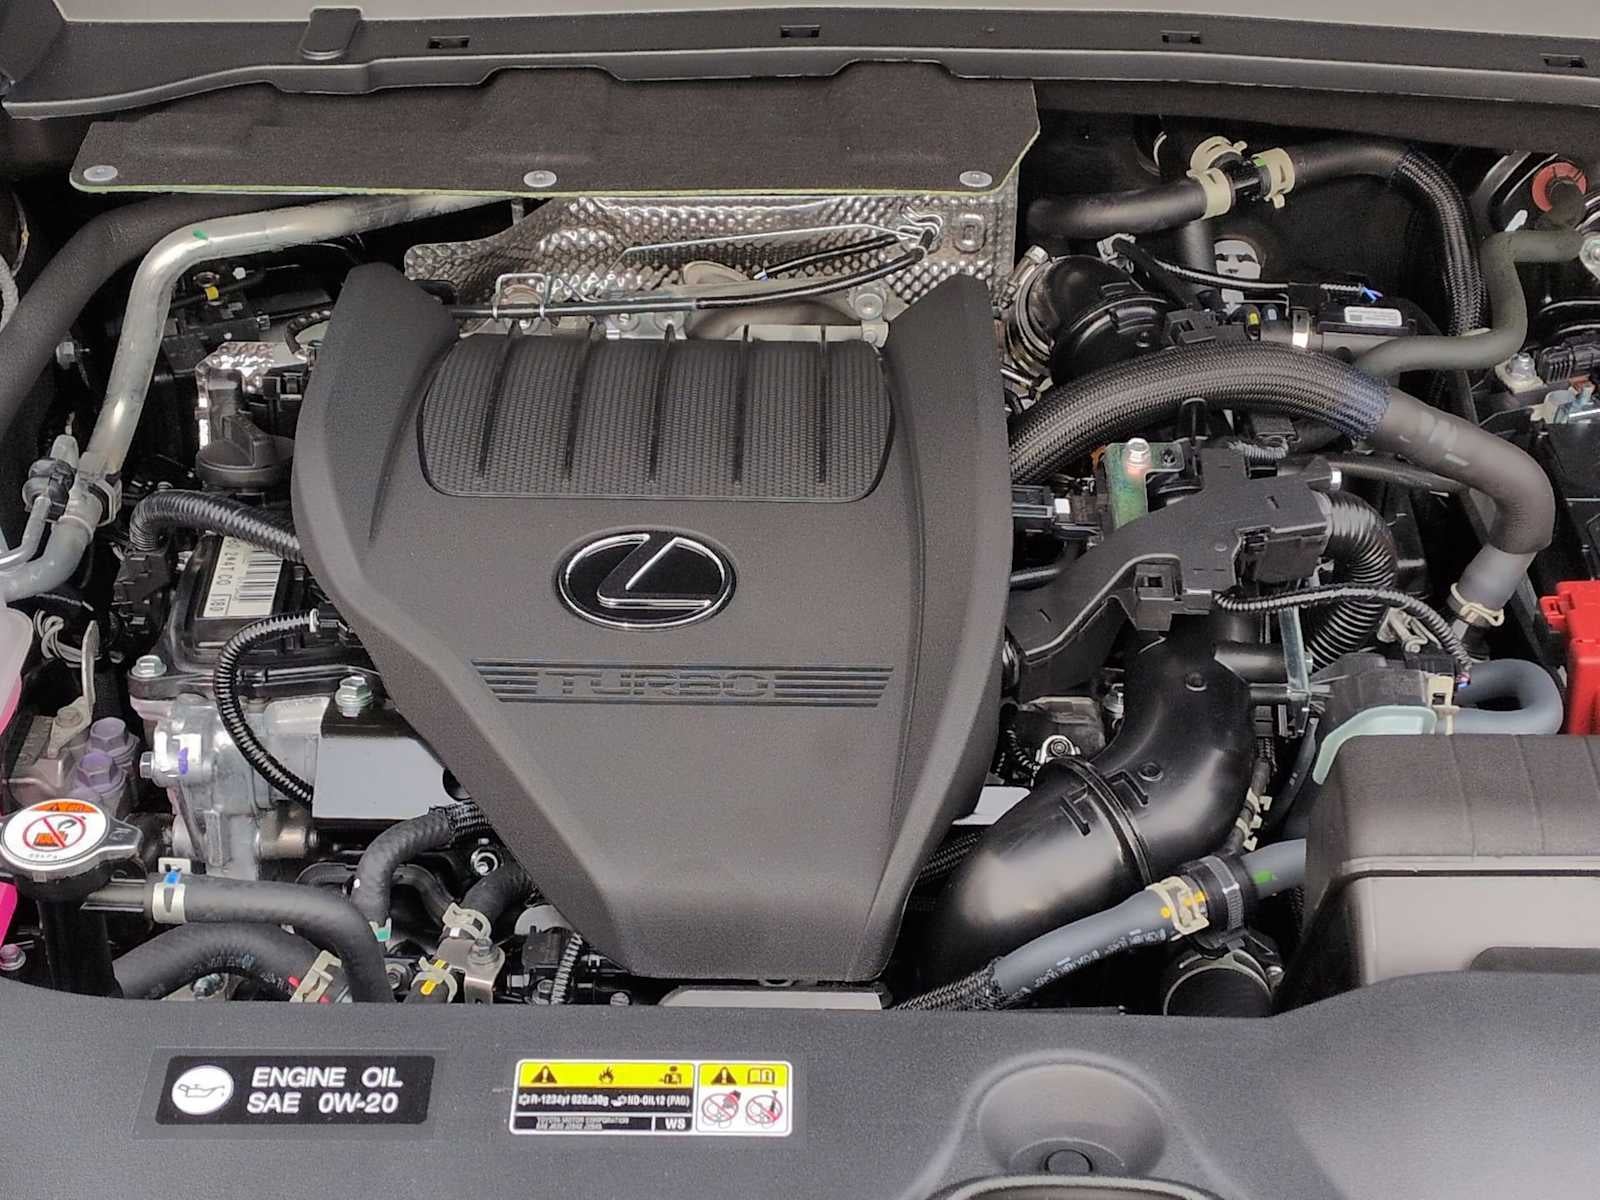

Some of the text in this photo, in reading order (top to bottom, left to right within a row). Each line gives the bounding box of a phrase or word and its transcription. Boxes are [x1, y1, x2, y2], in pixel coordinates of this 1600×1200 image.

[540, 671, 773, 701] TURBO
[251, 1066, 404, 1089] ENGINE OIL
[246, 1091, 399, 1114] SAE 0W-20
[665, 1117, 686, 1131] WS
